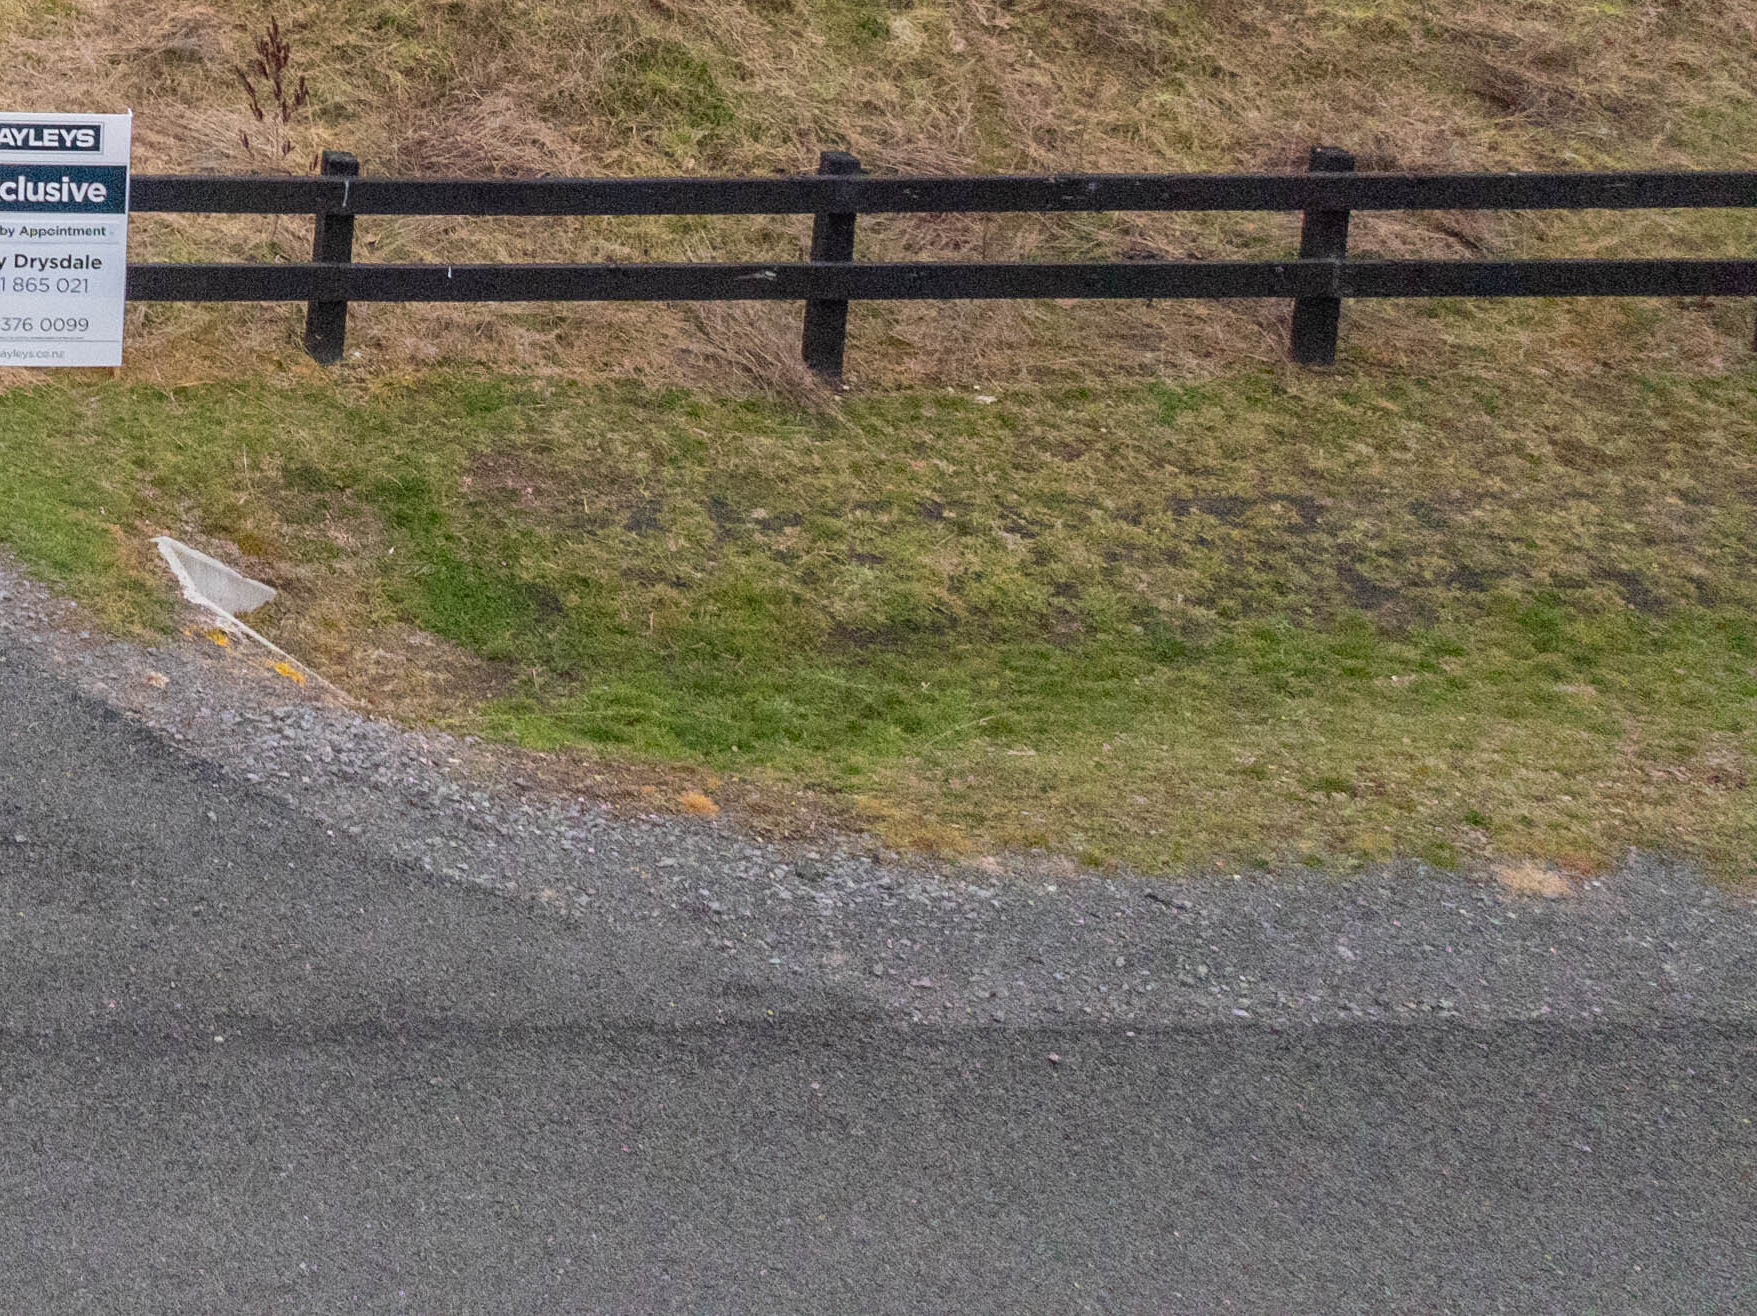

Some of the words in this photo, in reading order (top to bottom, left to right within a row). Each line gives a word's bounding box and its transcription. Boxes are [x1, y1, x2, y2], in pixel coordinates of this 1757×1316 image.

[0, 224, 15, 238] by
[19, 225, 107, 238] Appointment
[14, 253, 103, 272] Drysdale
[12, 276, 50, 293] 865
[56, 278, 89, 293] 021
[0, 317, 34, 332] 376
[40, 317, 89, 332] 0099
